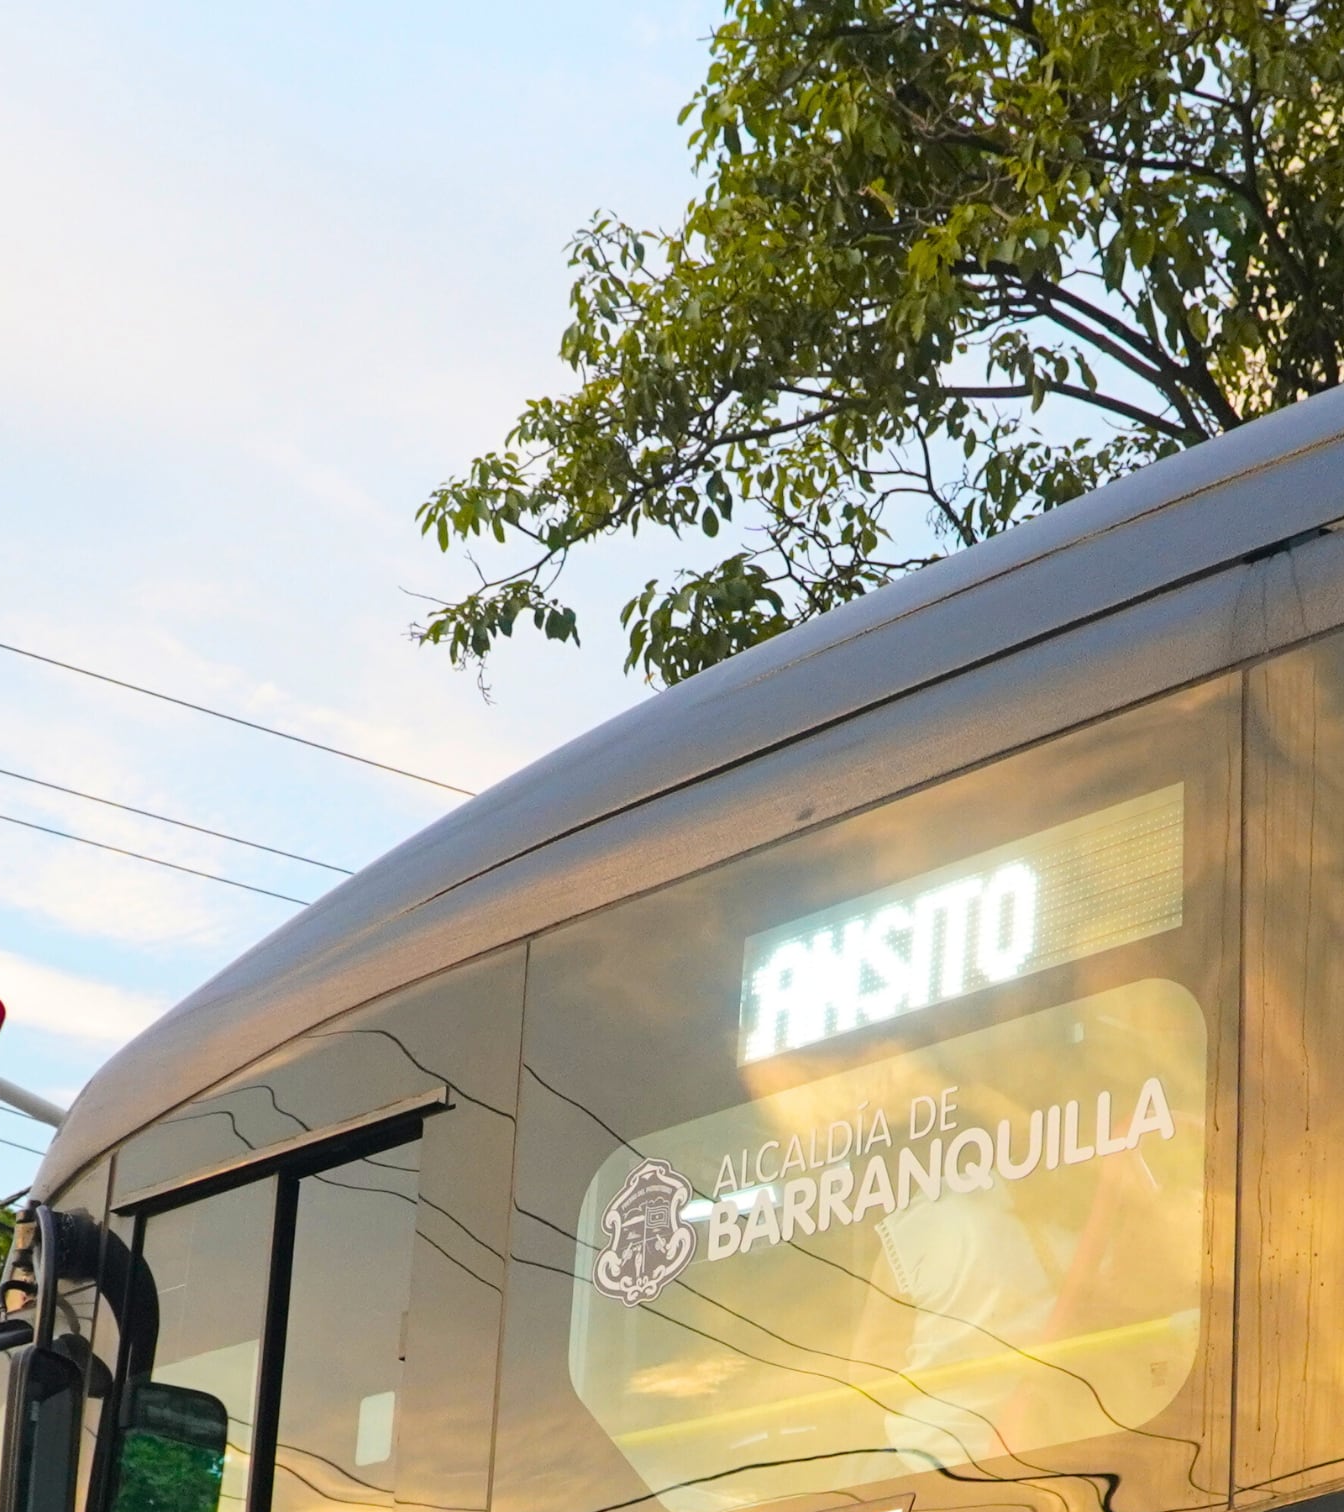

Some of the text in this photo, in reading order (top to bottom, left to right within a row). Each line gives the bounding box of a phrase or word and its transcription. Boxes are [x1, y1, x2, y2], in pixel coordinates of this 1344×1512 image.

[705, 1076, 1175, 1263] BARRANQUILLA
[712, 1086, 959, 1196] ALCALDÍA DE
